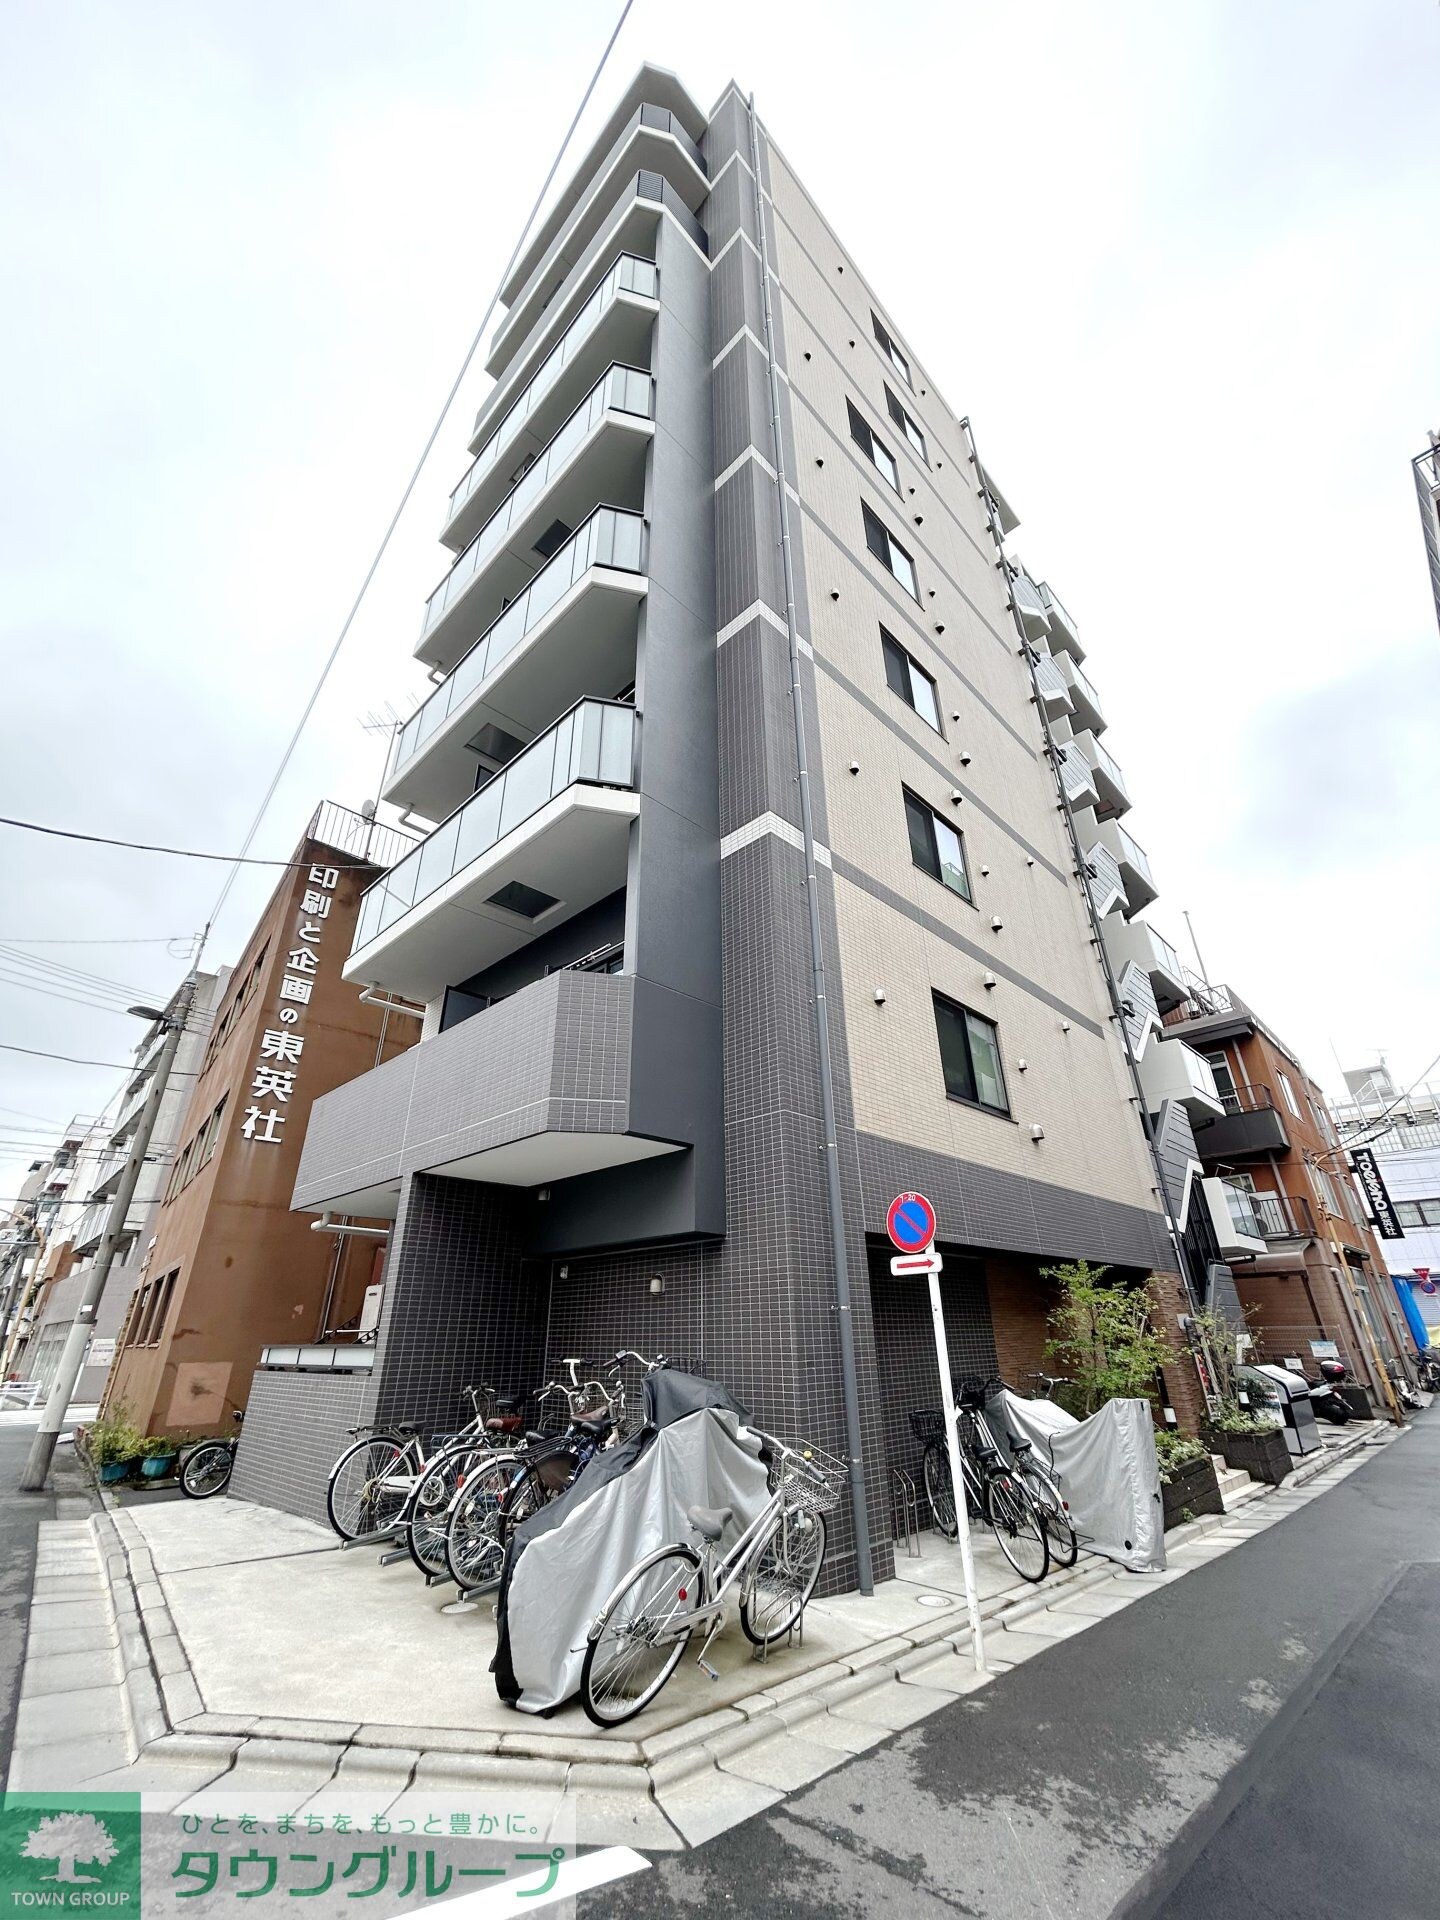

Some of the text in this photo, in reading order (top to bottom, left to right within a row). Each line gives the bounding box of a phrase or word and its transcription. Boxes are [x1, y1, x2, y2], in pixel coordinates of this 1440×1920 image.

[241, 863, 339, 1143] 印刷と企画の東英社
